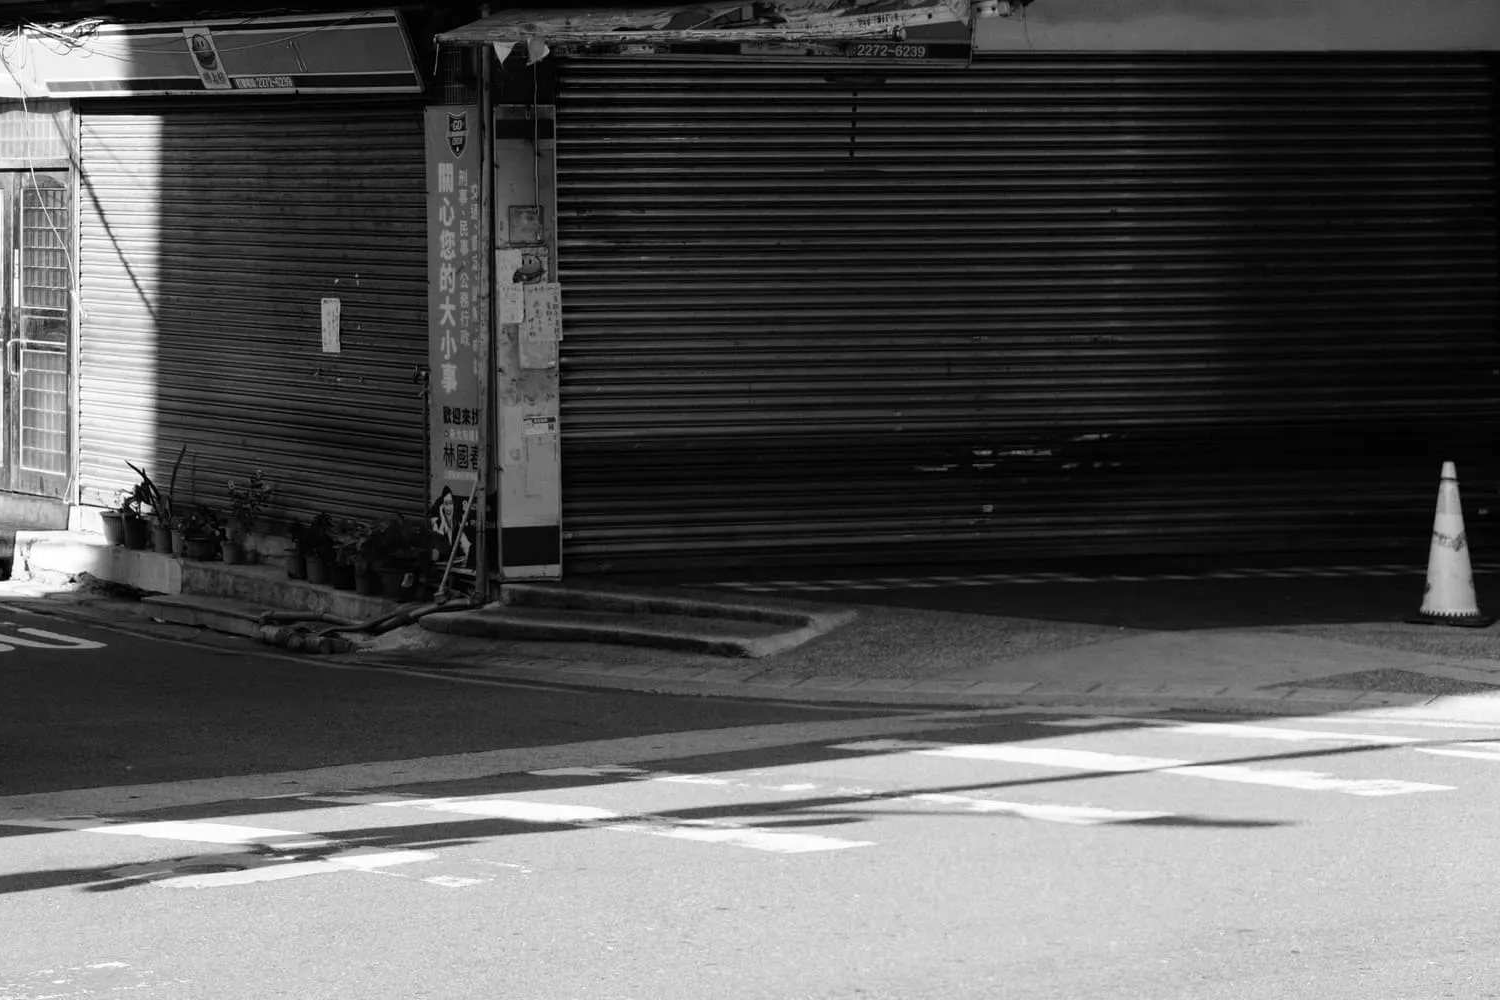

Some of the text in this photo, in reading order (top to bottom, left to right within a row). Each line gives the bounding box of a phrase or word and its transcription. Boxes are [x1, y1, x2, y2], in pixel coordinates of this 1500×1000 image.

[437, 162, 458, 395] 關心您的大小事
